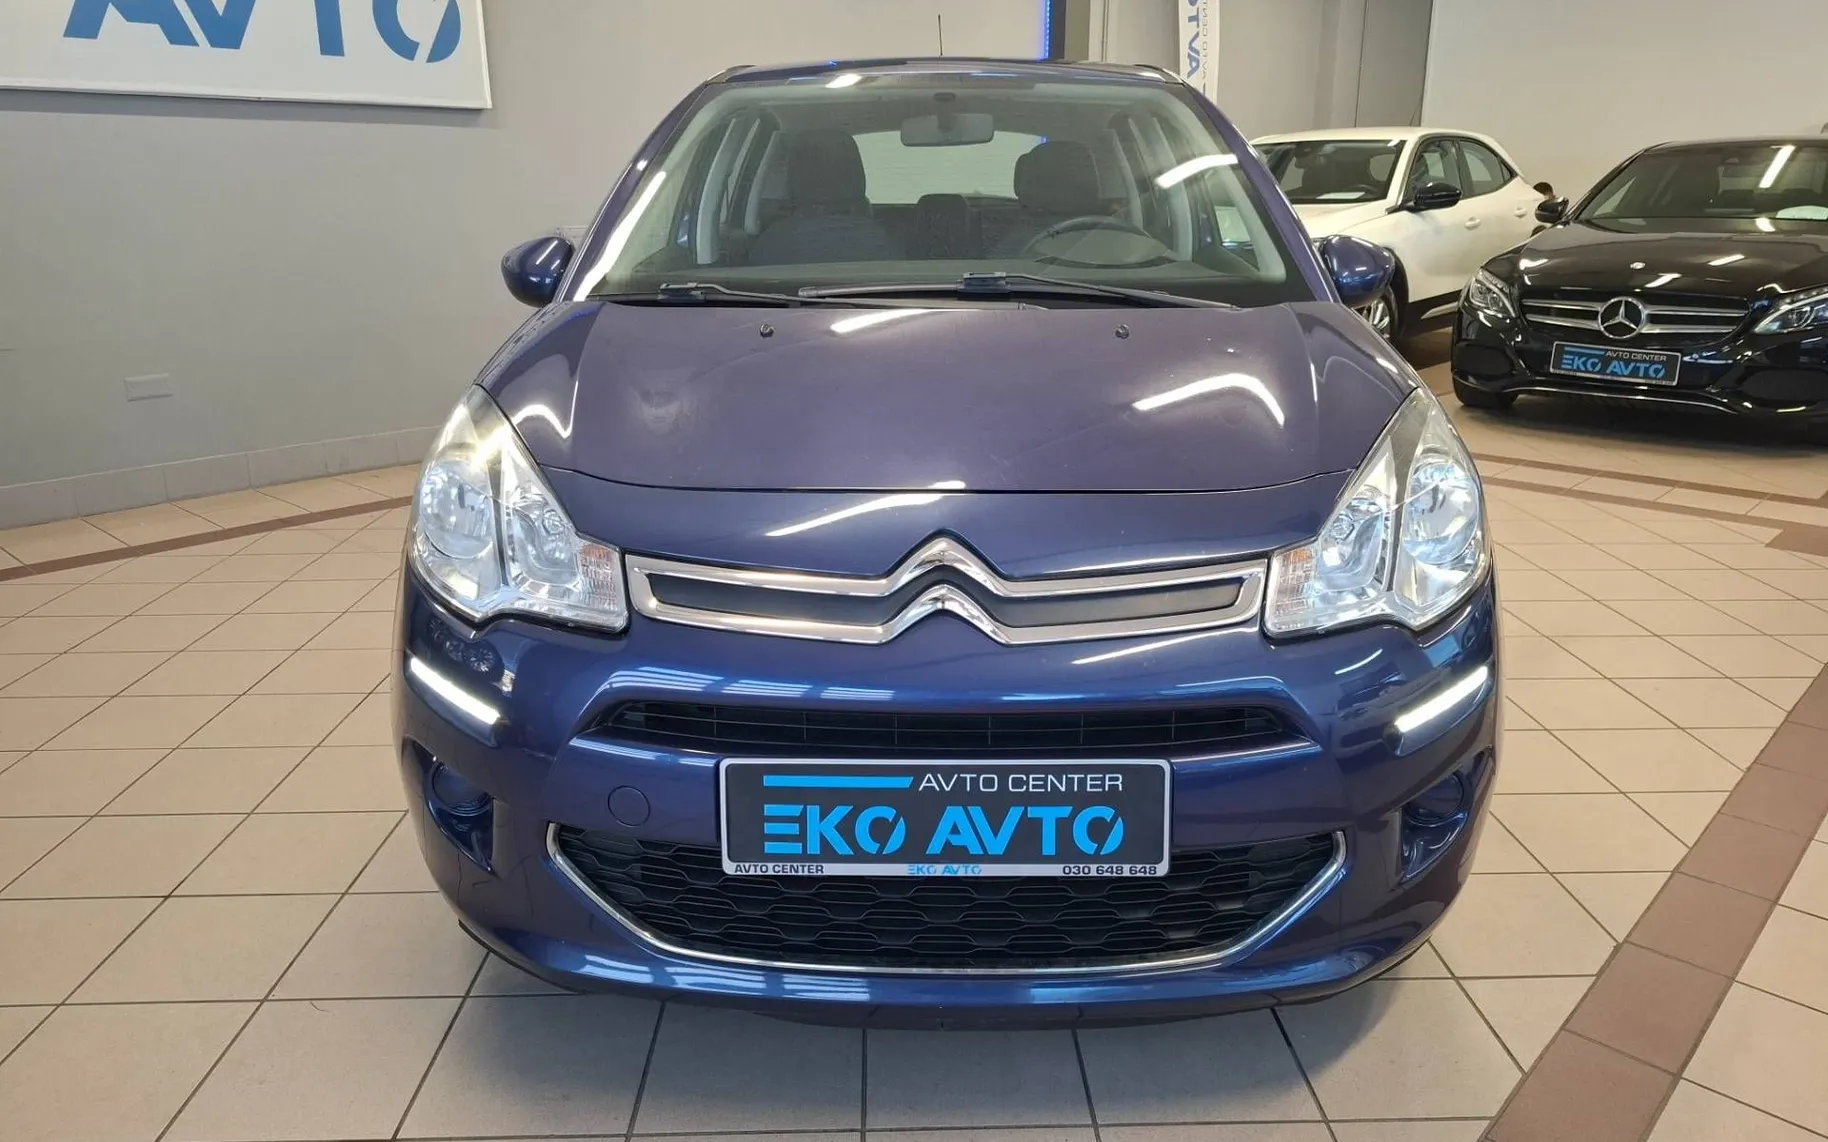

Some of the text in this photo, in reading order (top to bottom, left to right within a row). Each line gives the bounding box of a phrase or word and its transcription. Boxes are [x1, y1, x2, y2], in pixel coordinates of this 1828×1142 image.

[1605, 350, 1667, 362] AVTO CENTER
[1561, 354, 1602, 373] EKO
[1605, 359, 1665, 378] AVTO
[918, 773, 1123, 792] AVTO CENTER
[763, 804, 1124, 856] EKO AVTO
[734, 864, 824, 874] AVTO CENTER
[907, 864, 982, 875] EKO AVTO
[1062, 865, 1157, 876] 030 648 648
